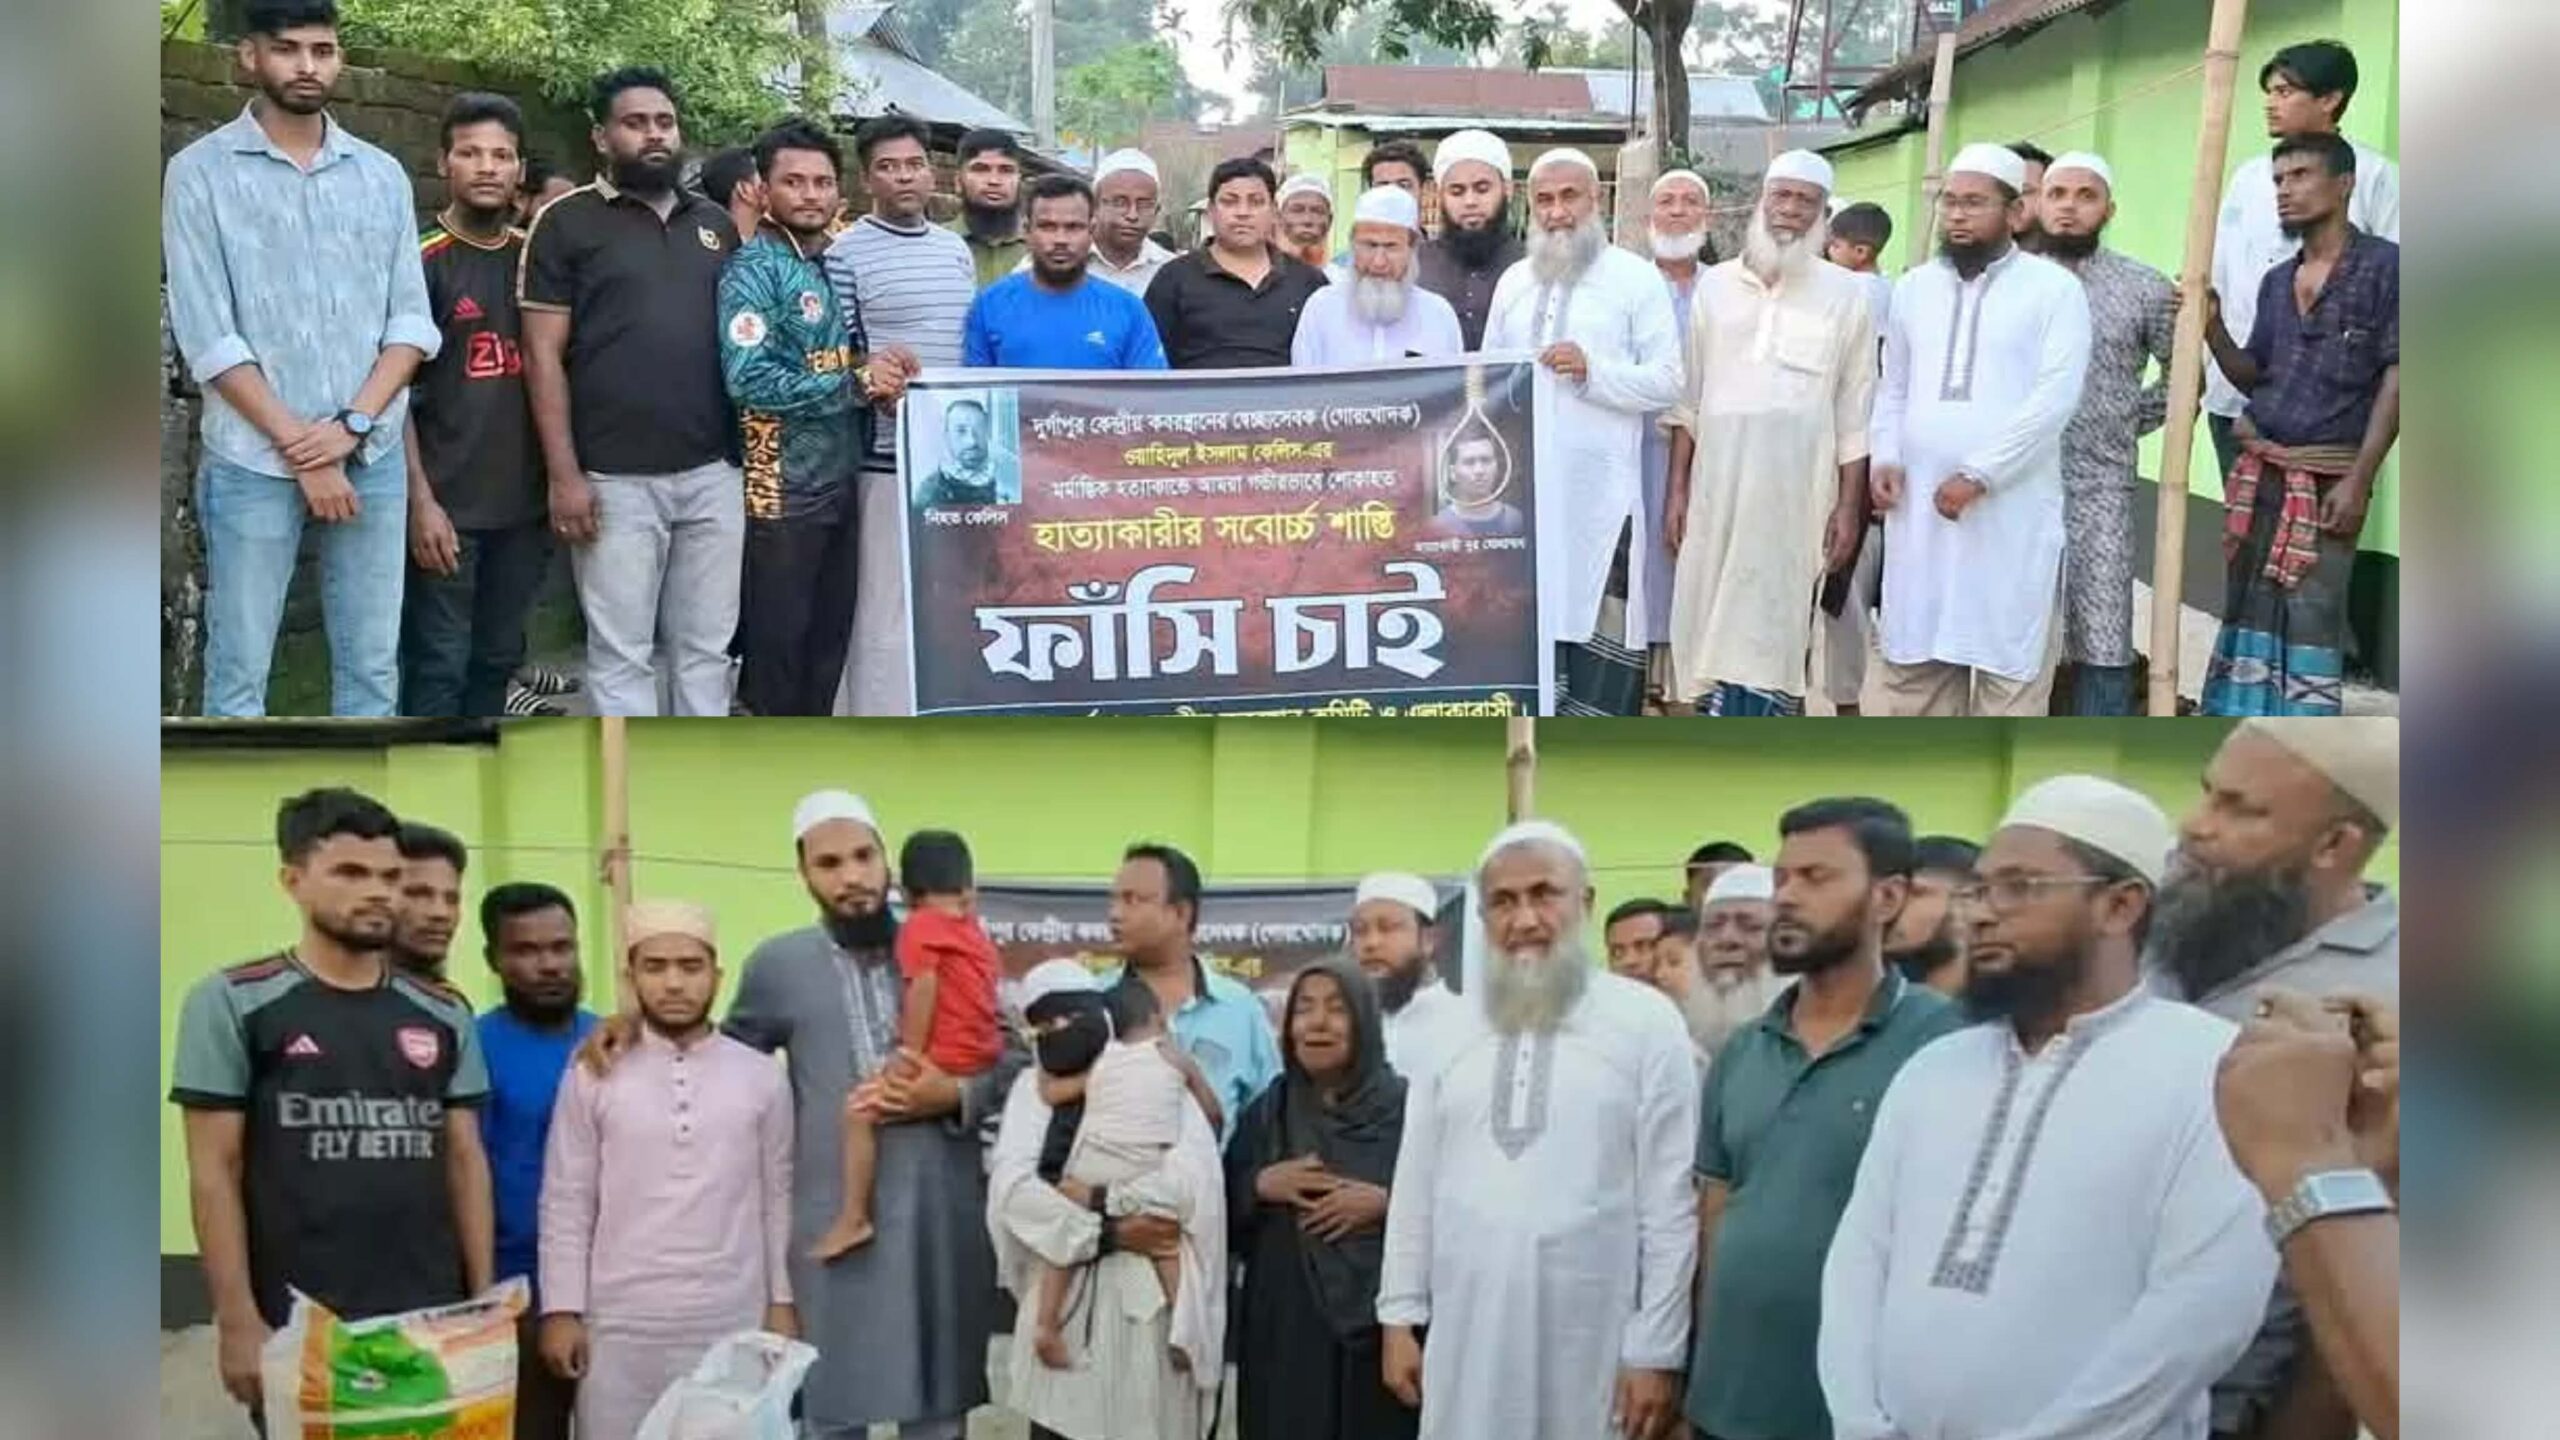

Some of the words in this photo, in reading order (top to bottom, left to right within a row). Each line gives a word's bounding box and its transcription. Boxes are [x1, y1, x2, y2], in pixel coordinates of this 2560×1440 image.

[1193, 440, 1249, 465] ইসলাম
[1031, 506, 1205, 553] হত্যাকারীর
[1324, 500, 1396, 542] শাস্তি
[974, 565, 1243, 681] ফাঁসি
[1265, 561, 1446, 680] চাই
[276, 1090, 444, 1128] Emirate
[311, 1130, 353, 1161] FLY
